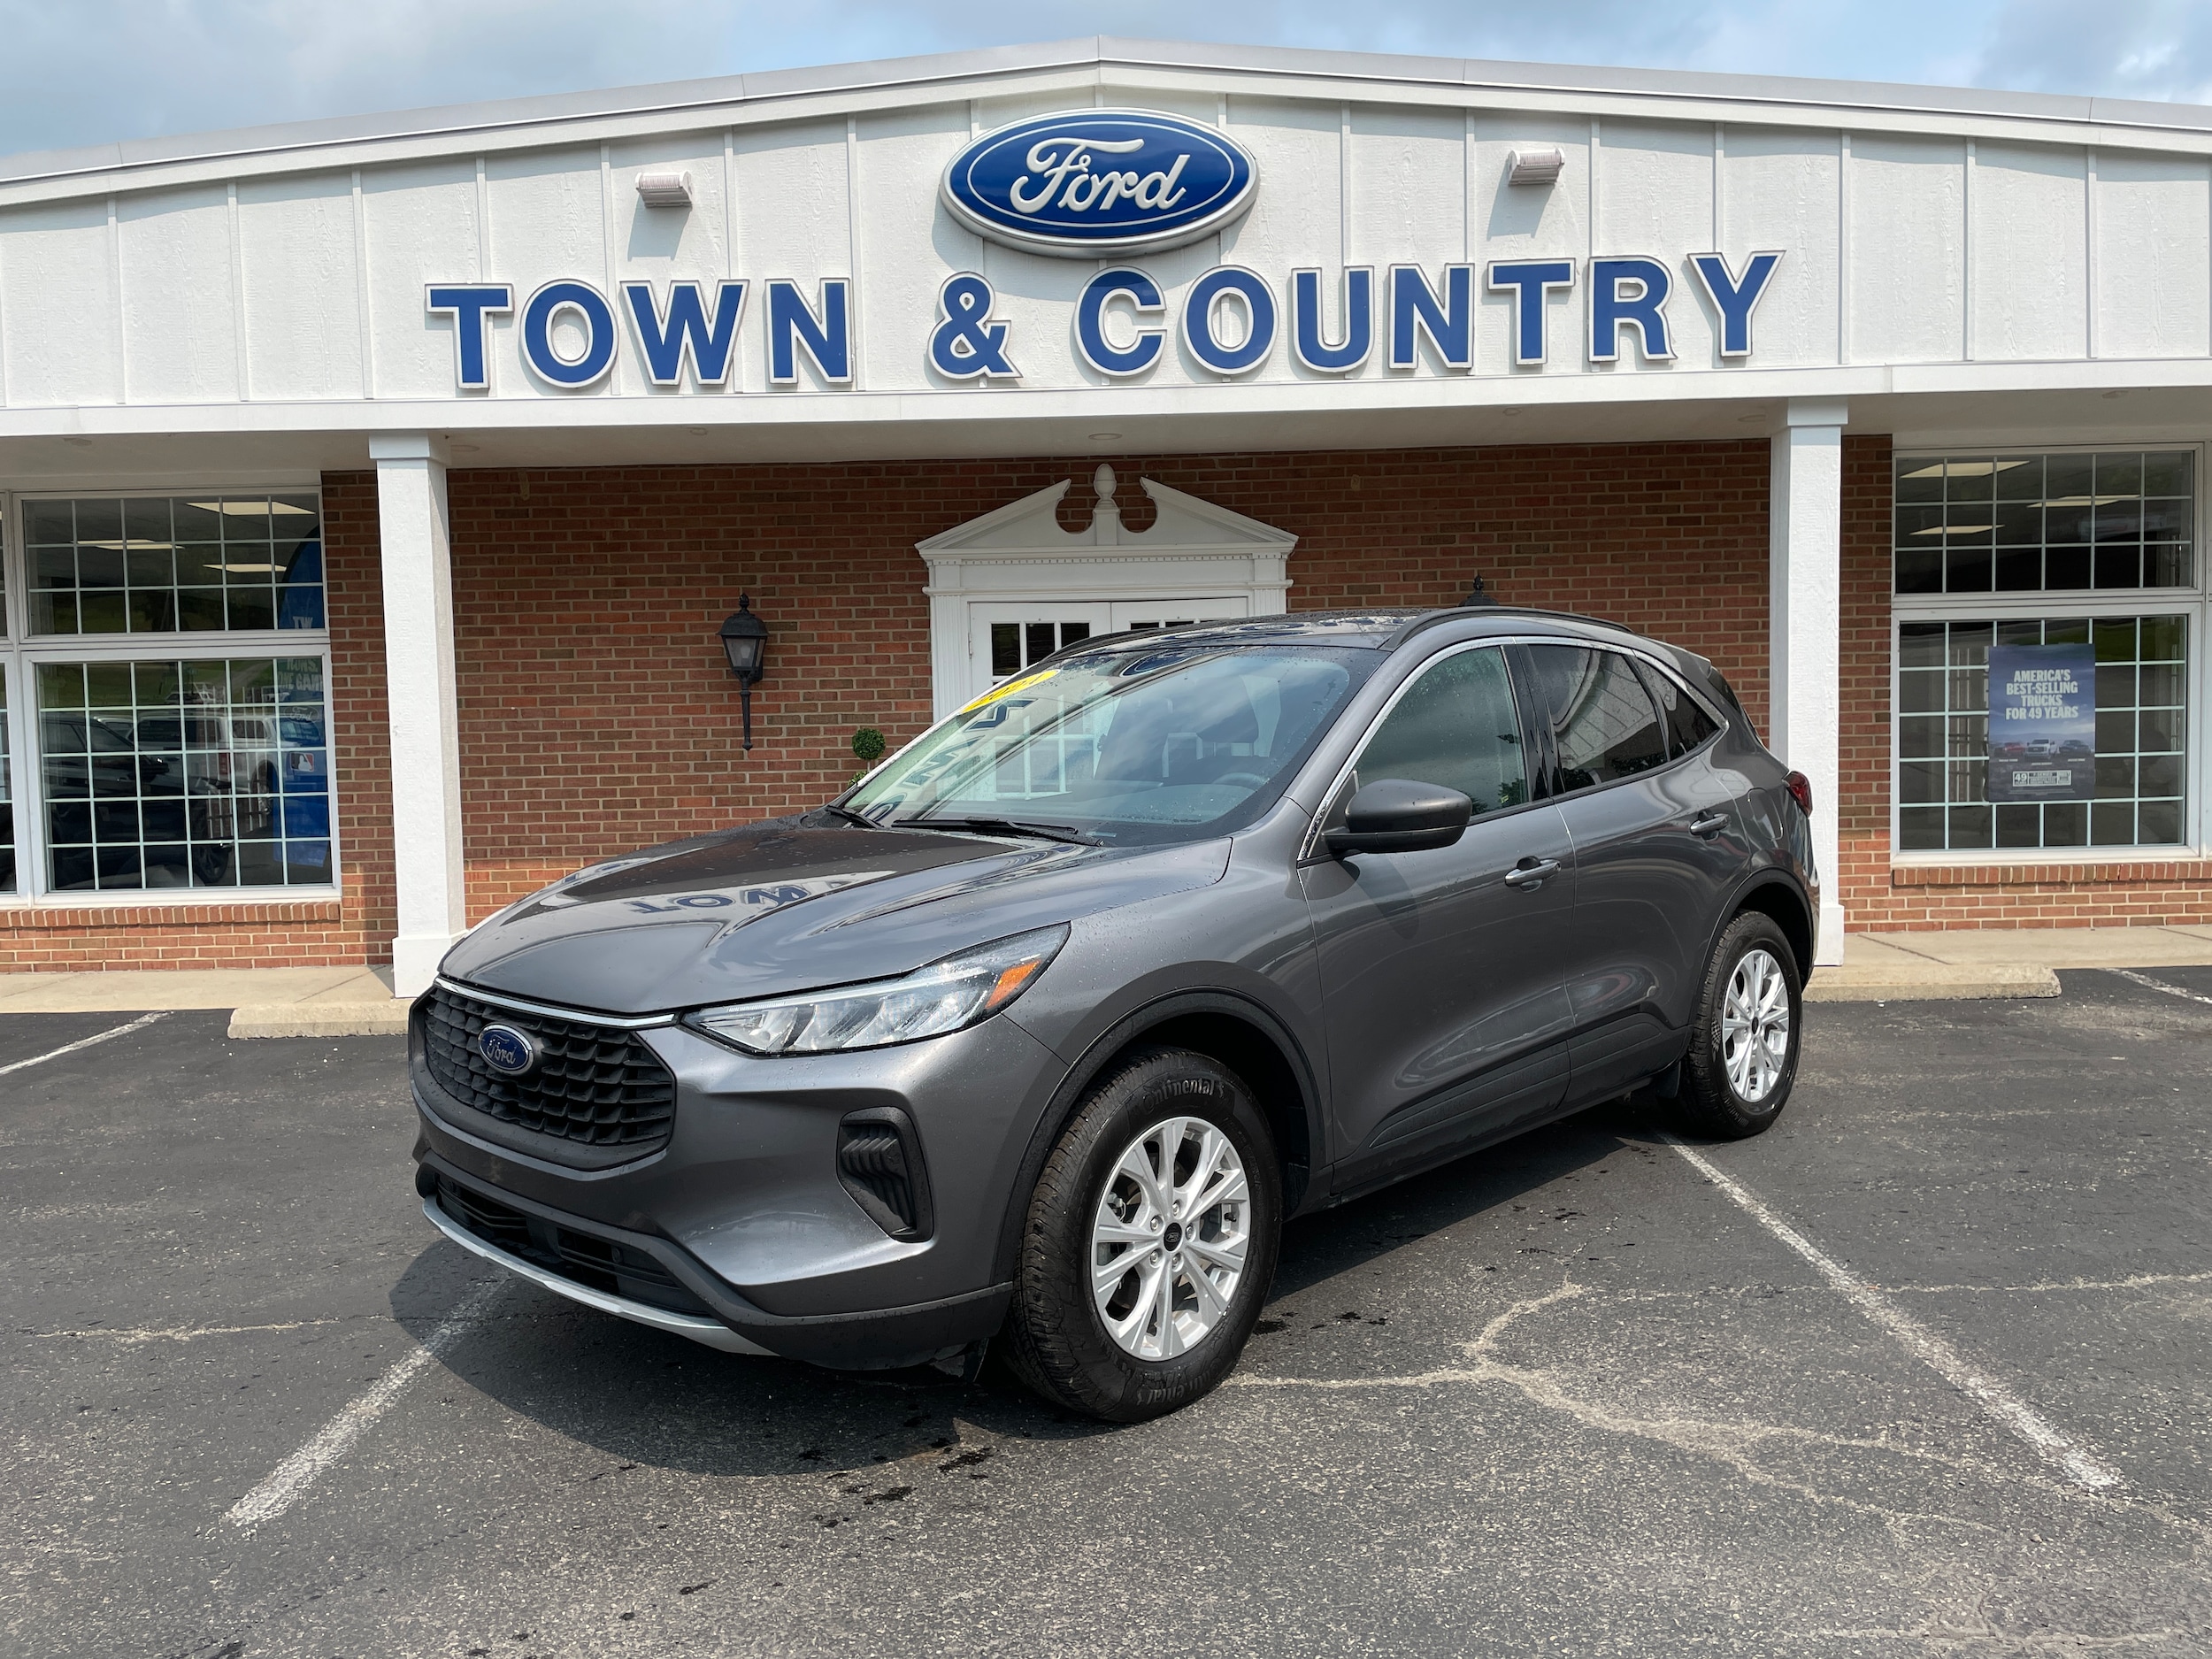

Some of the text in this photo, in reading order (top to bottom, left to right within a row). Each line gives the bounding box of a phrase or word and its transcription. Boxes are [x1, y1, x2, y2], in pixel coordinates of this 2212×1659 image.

[1010, 137, 1191, 214] Ford
[426, 250, 1786, 389] TOWN & COUNTRY
[2014, 669, 2071, 682] AMERICA'S
[2006, 681, 2078, 695] BEST-SELLING
[2021, 695, 2062, 707] TRUCKS
[2005, 706, 2079, 720] FOR 49 YEARS
[486, 1033, 518, 1065] Ford
